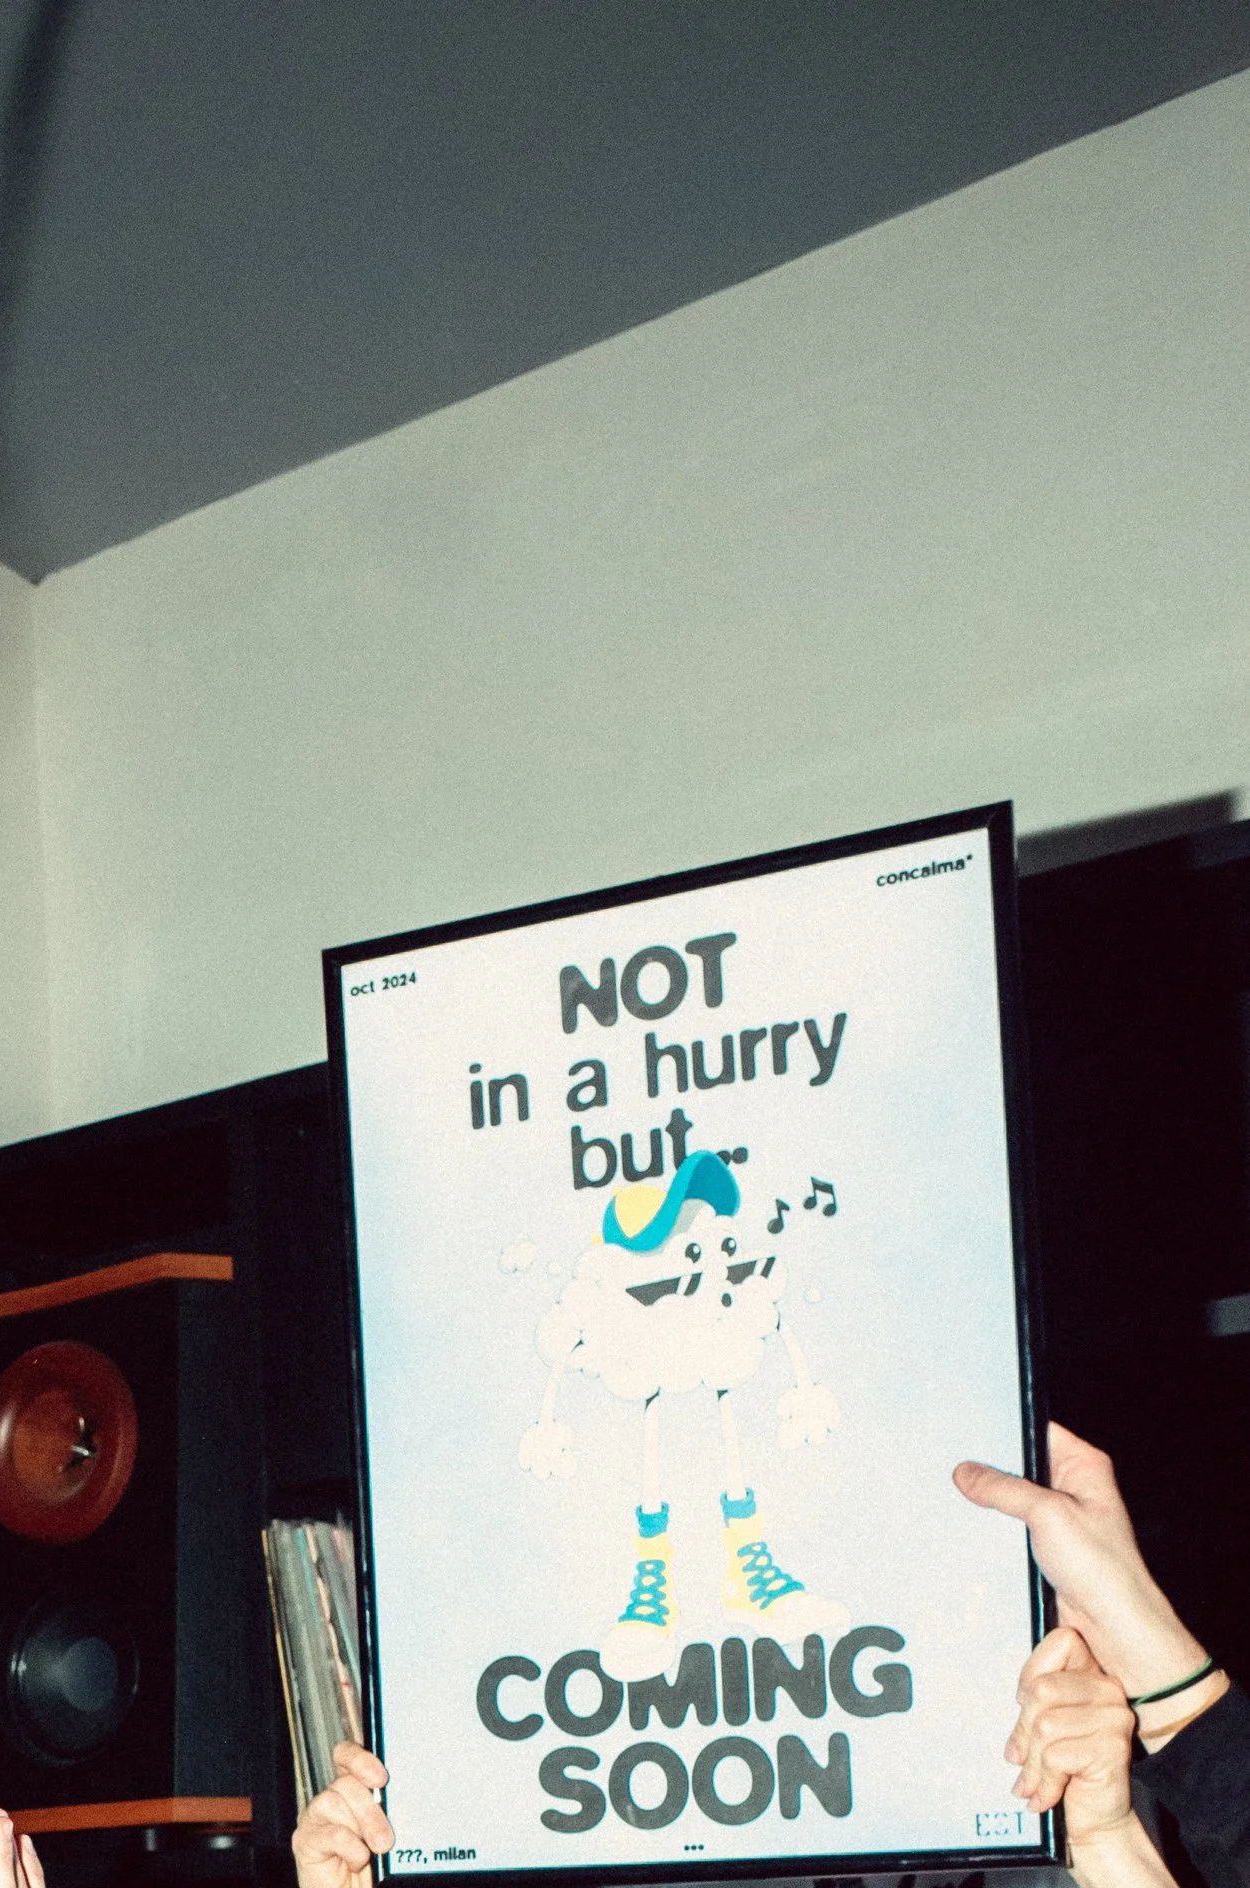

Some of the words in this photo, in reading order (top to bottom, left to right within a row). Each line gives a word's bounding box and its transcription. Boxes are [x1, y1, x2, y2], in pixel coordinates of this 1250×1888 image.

[350, 980, 375, 996] oct
[382, 971, 417, 990] 2024
[559, 932, 737, 1033] NOT
[469, 1063, 530, 1129] in
[566, 1059, 608, 1112] a
[645, 1012, 848, 1098] hurry
[476, 1625, 913, 1741] COMING
[539, 1732, 853, 1833] SOON
[433, 1846, 477, 1861] milan
